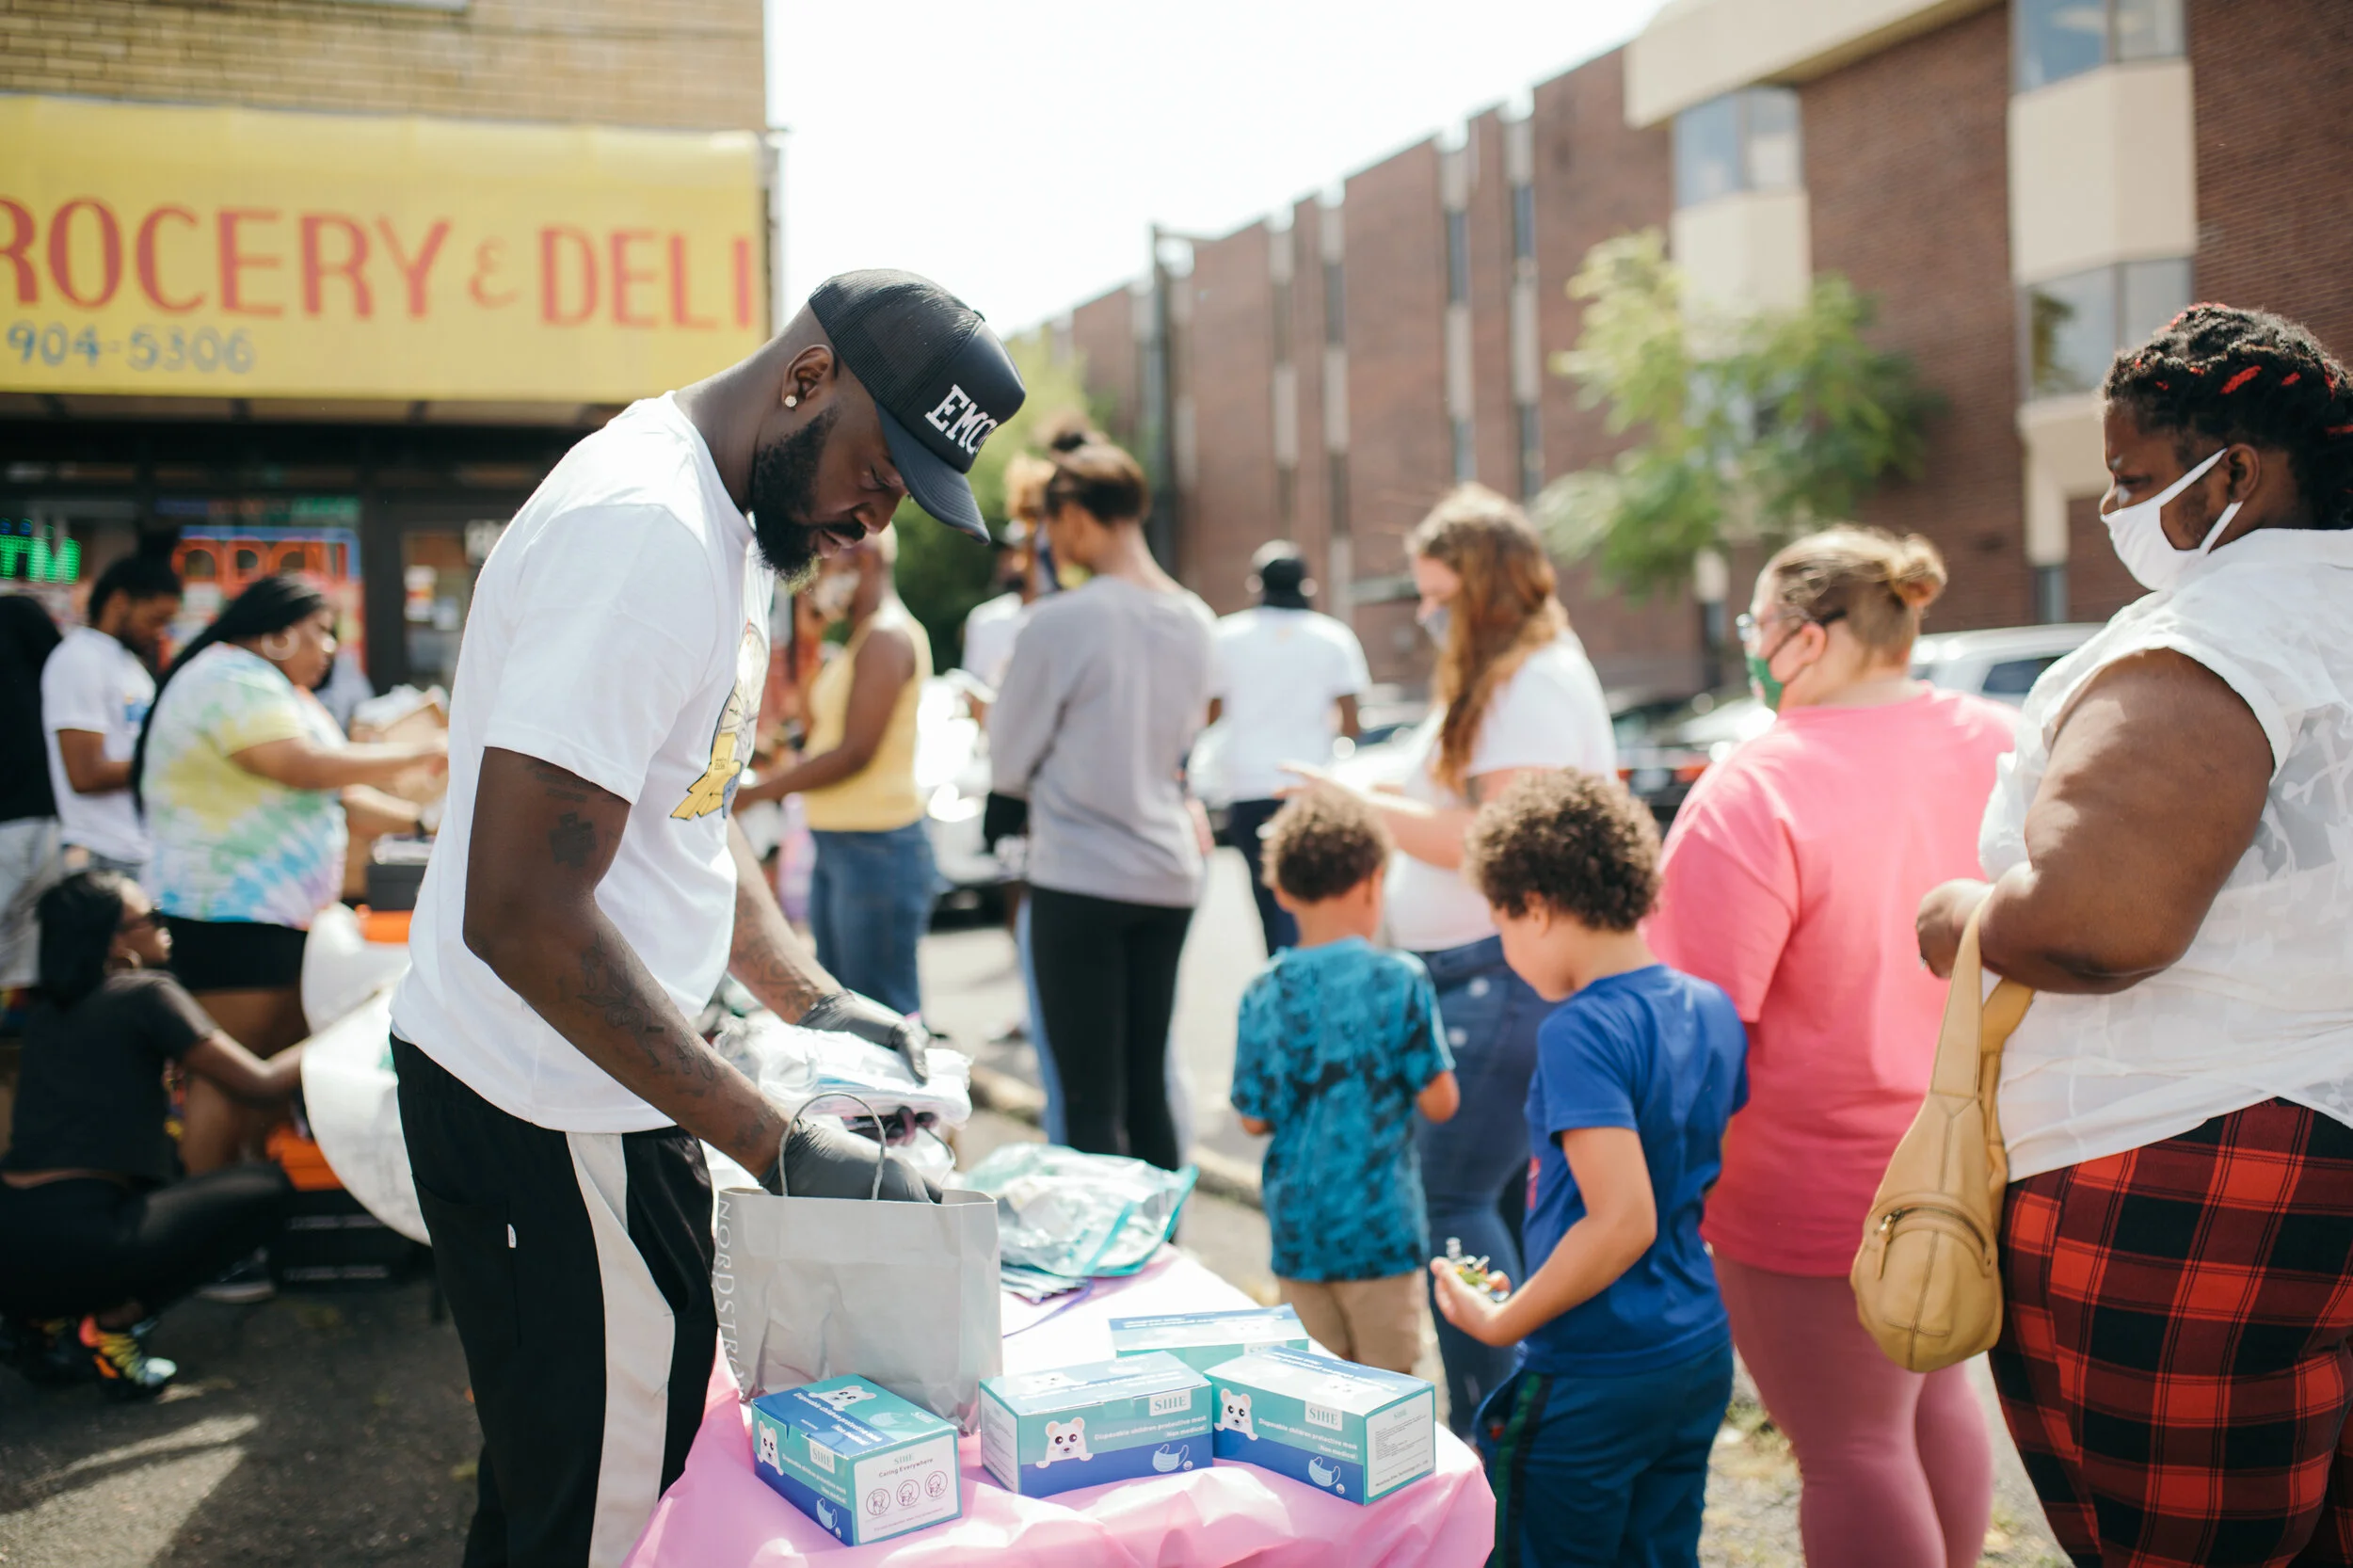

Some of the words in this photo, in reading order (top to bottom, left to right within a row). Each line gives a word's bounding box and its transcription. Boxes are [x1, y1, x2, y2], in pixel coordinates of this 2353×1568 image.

[539, 226, 753, 328] DELI
[8, 320, 255, 373] 904-5306
[878, 1466, 899, 1479] Caring
[899, 1458, 934, 1473] Everywhere
